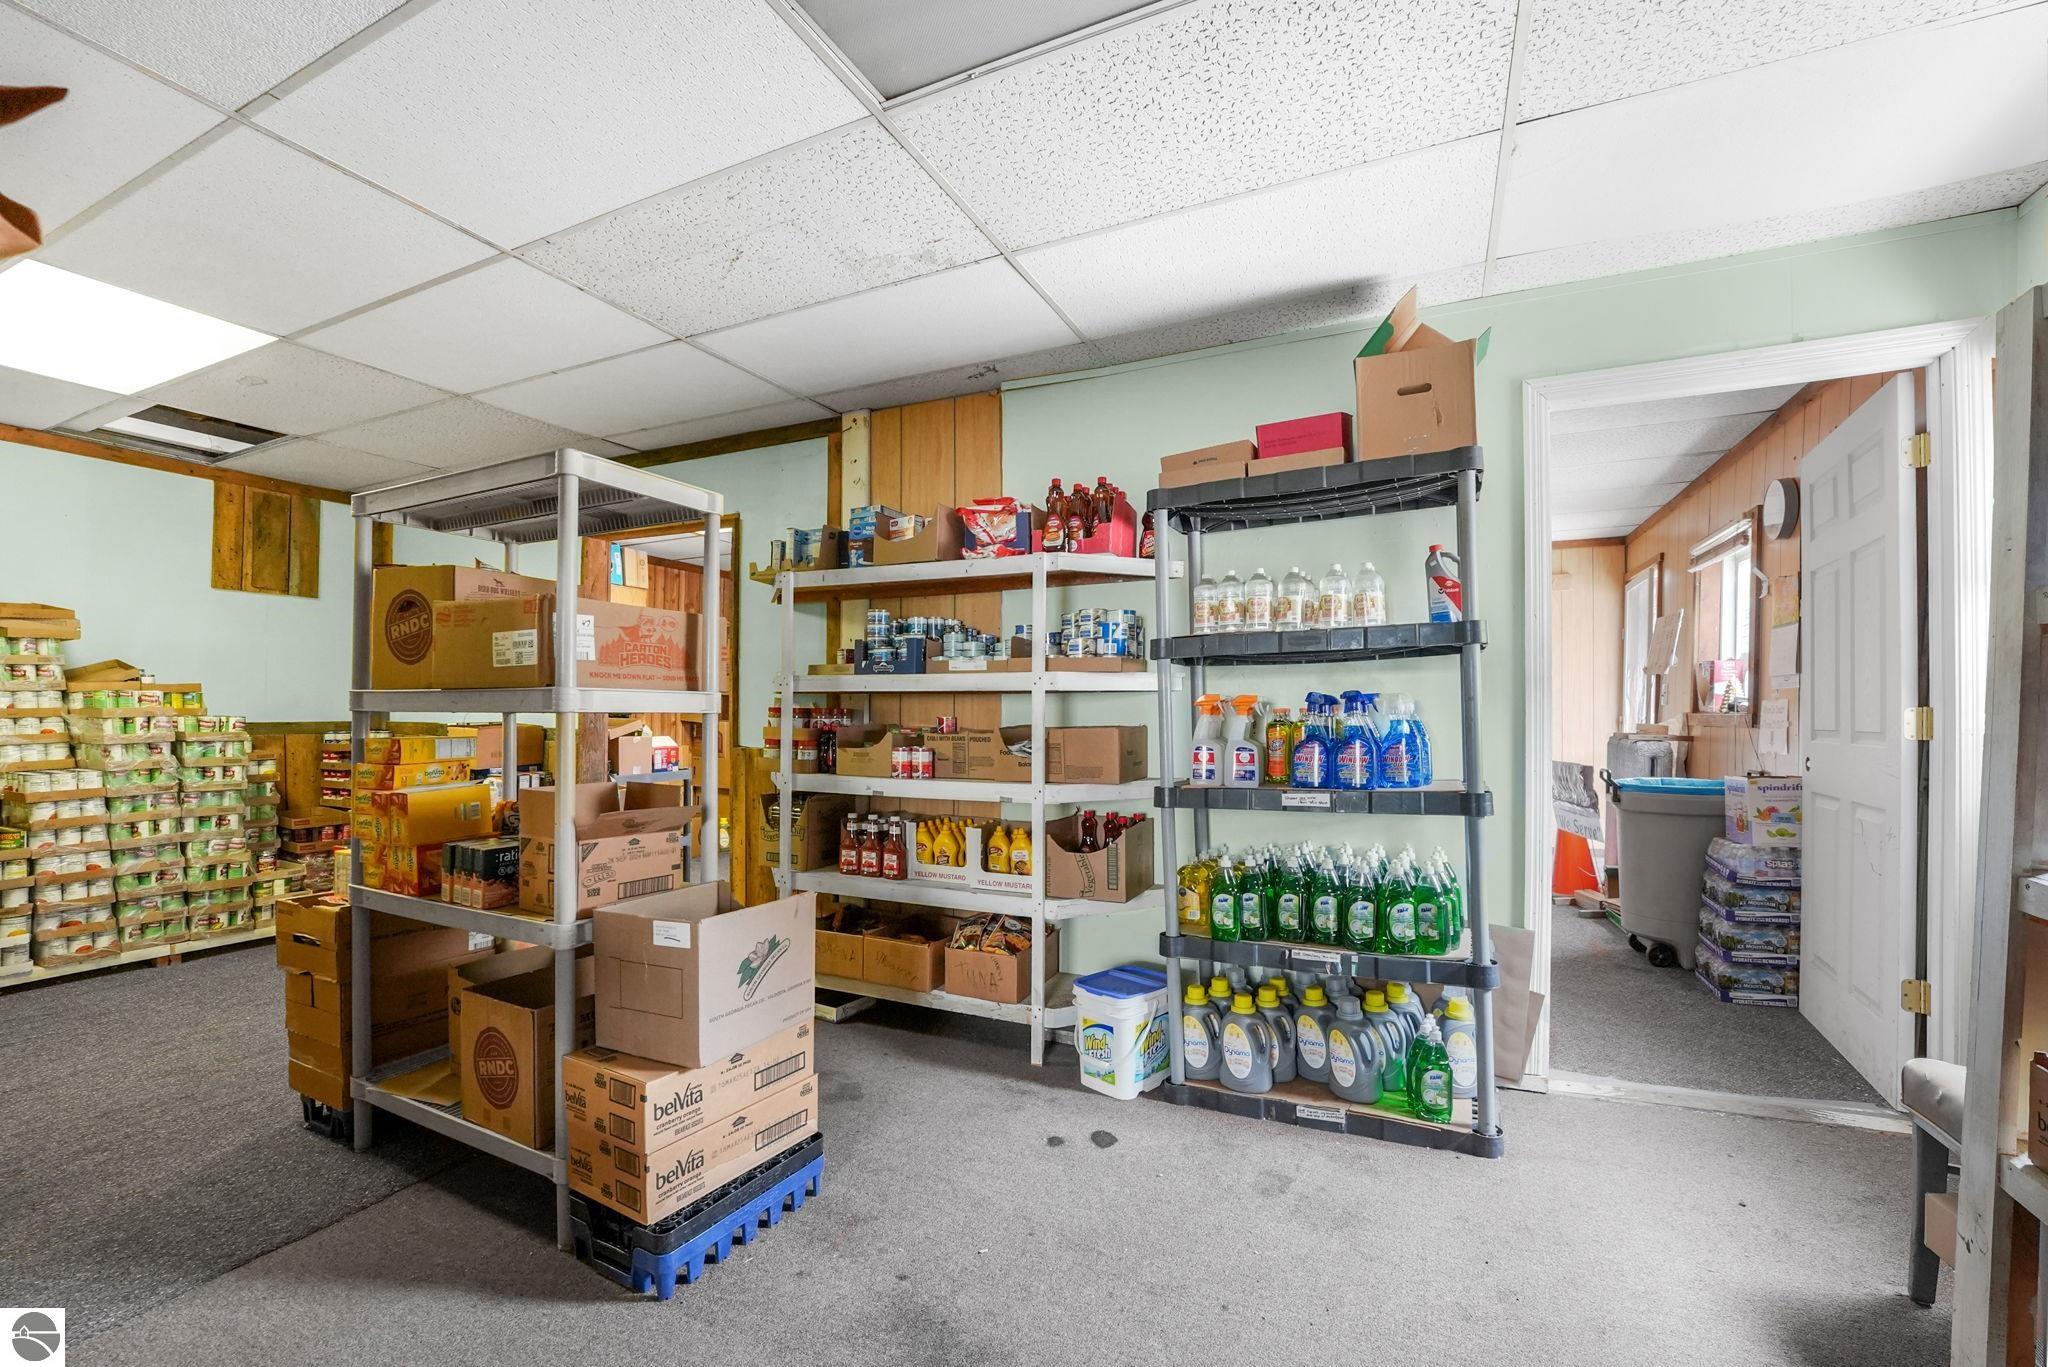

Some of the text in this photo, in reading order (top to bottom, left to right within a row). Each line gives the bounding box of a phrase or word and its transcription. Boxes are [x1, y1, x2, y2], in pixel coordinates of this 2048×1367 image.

[390, 613, 431, 640] RNDC
[624, 643, 668, 655] CARTON
[620, 653, 673, 669] HEROES
[589, 671, 612, 679] KNOCK
[1295, 754, 1324, 763] WINDW
[495, 849, 519, 862] :rati
[1766, 860, 1794, 868] splas
[914, 871, 967, 881] YELLOW MUSTARD
[1299, 1037, 1325, 1048] Dynamo
[1088, 1045, 1112, 1061] Fresh
[1224, 1045, 1251, 1057] Dynamo
[1330, 1055, 1355, 1066] Dynamo
[478, 1060, 515, 1076] RNDC
[653, 1082, 703, 1122] belVita
[656, 1115, 683, 1131] cranberry
[682, 1107, 702, 1119] orange
[655, 1149, 704, 1191] belVita
[658, 1182, 683, 1198] cranberry
[683, 1172, 702, 1186] orange
